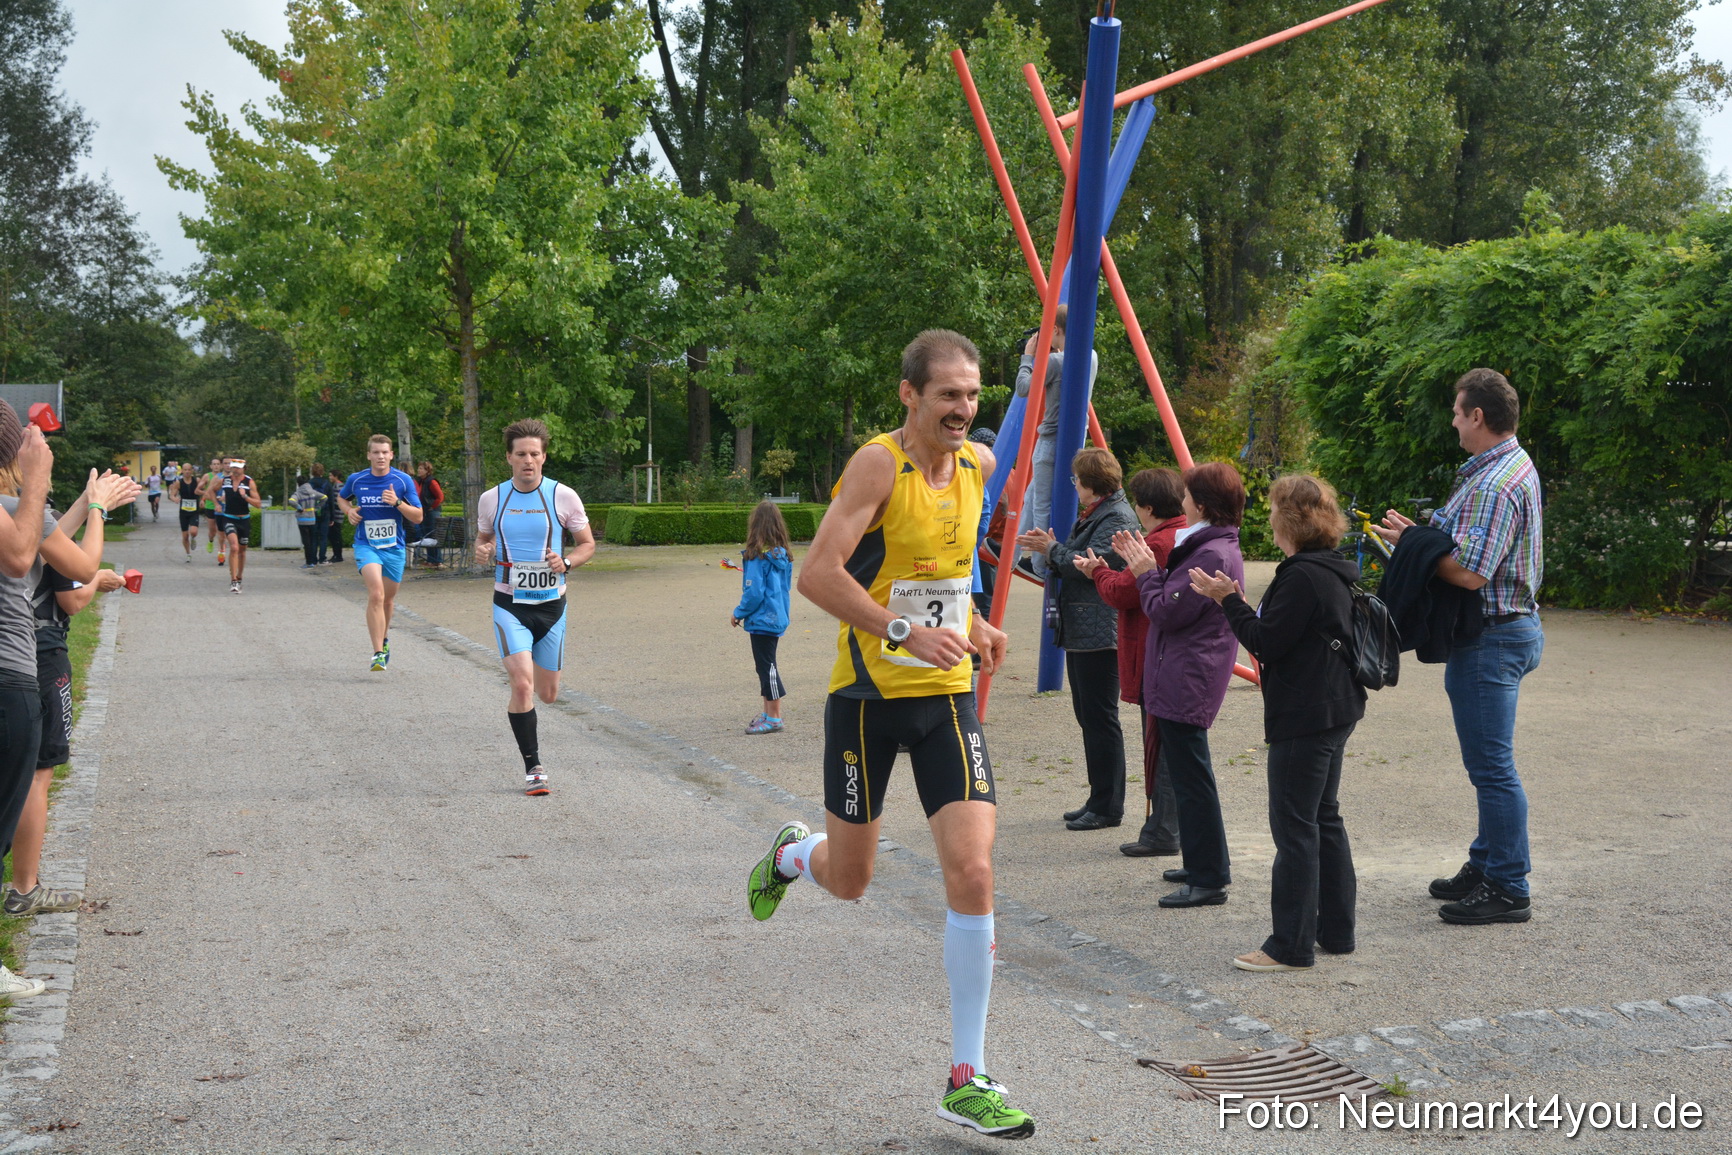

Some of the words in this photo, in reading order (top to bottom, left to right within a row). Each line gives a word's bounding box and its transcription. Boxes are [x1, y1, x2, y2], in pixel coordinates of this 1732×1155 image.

[368, 526, 394, 538] 2430
[913, 561, 937, 571] Seidl
[518, 572, 556, 588] 2006
[525, 591, 549, 599] Michael
[893, 588, 923, 597] PARTL
[925, 587, 964, 596] Neumarkt
[925, 600, 943, 628] 3
[968, 732, 986, 780] SKINS
[845, 764, 858, 816] SKINS
